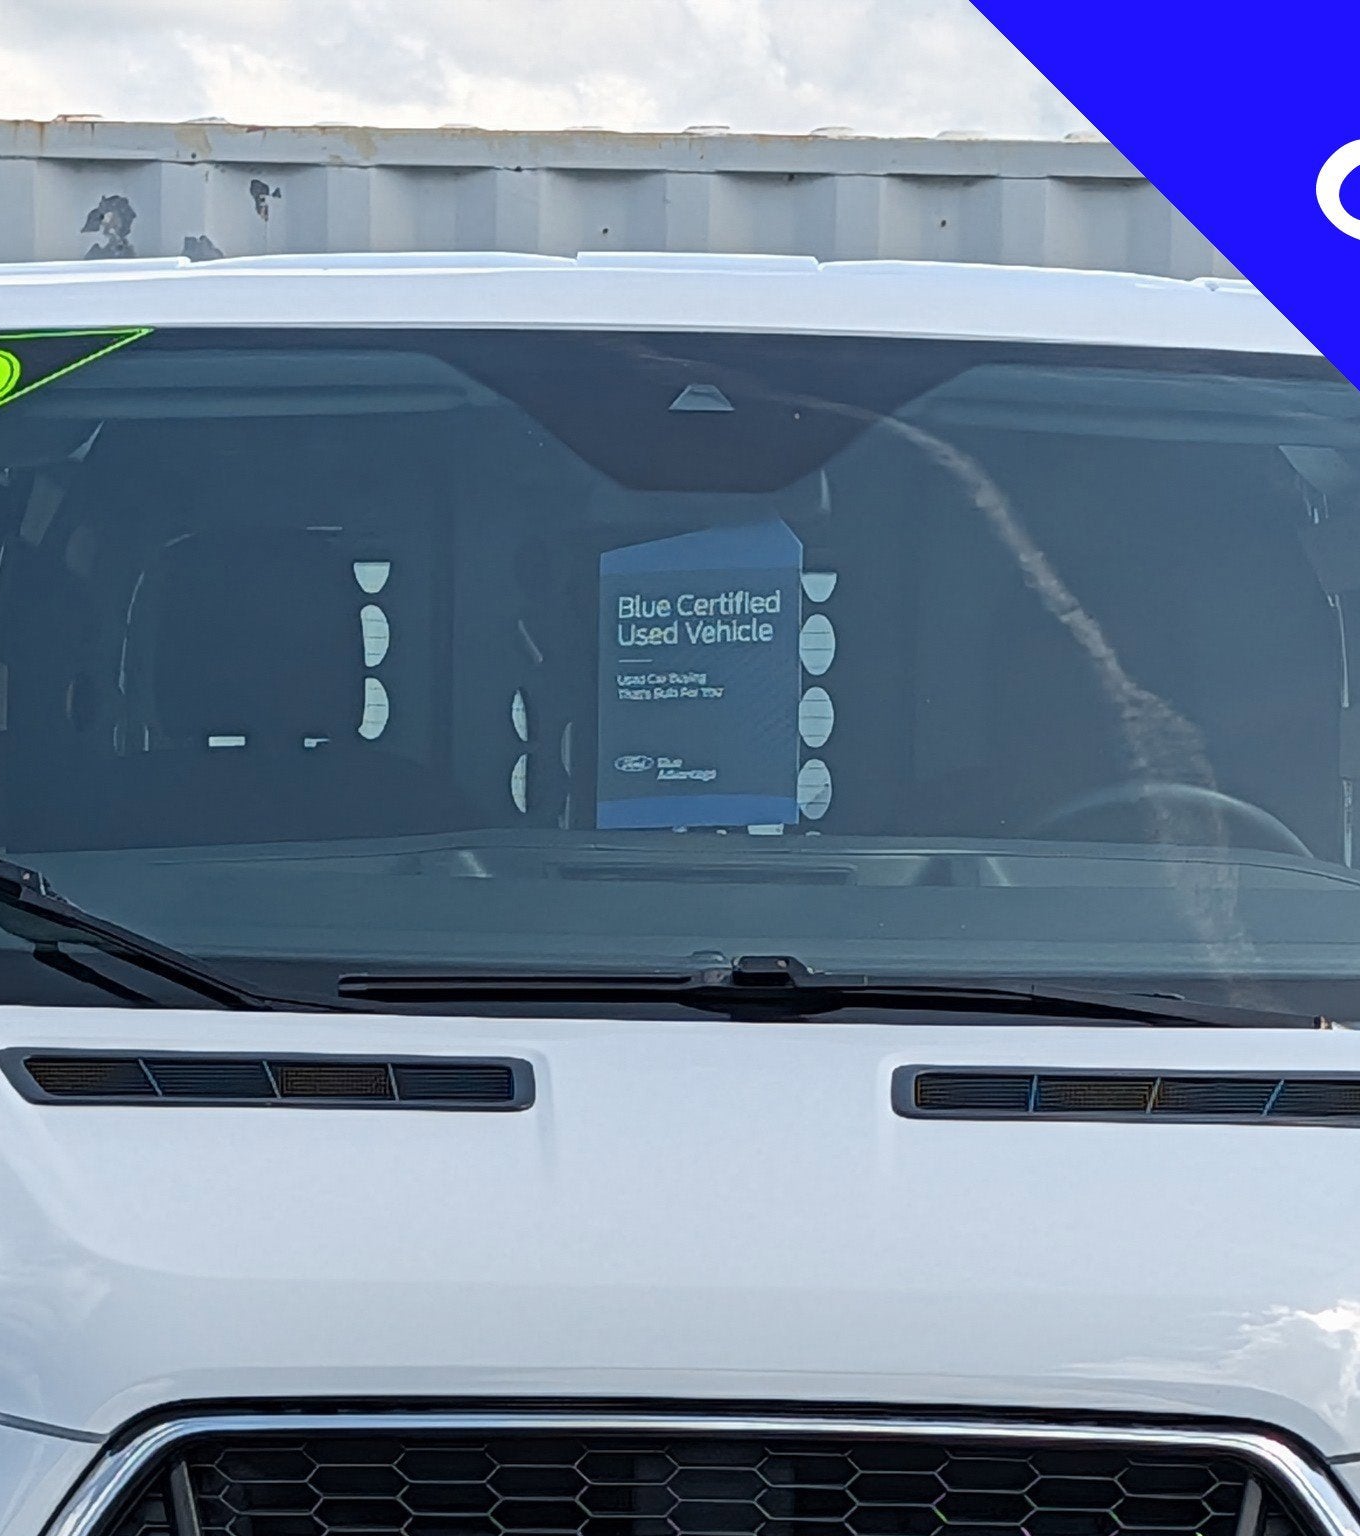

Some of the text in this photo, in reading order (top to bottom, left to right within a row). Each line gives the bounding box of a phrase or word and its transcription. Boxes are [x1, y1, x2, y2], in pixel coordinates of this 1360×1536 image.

[618, 590, 781, 619] Blue Certified
[618, 618, 774, 646] Used Vehicle
